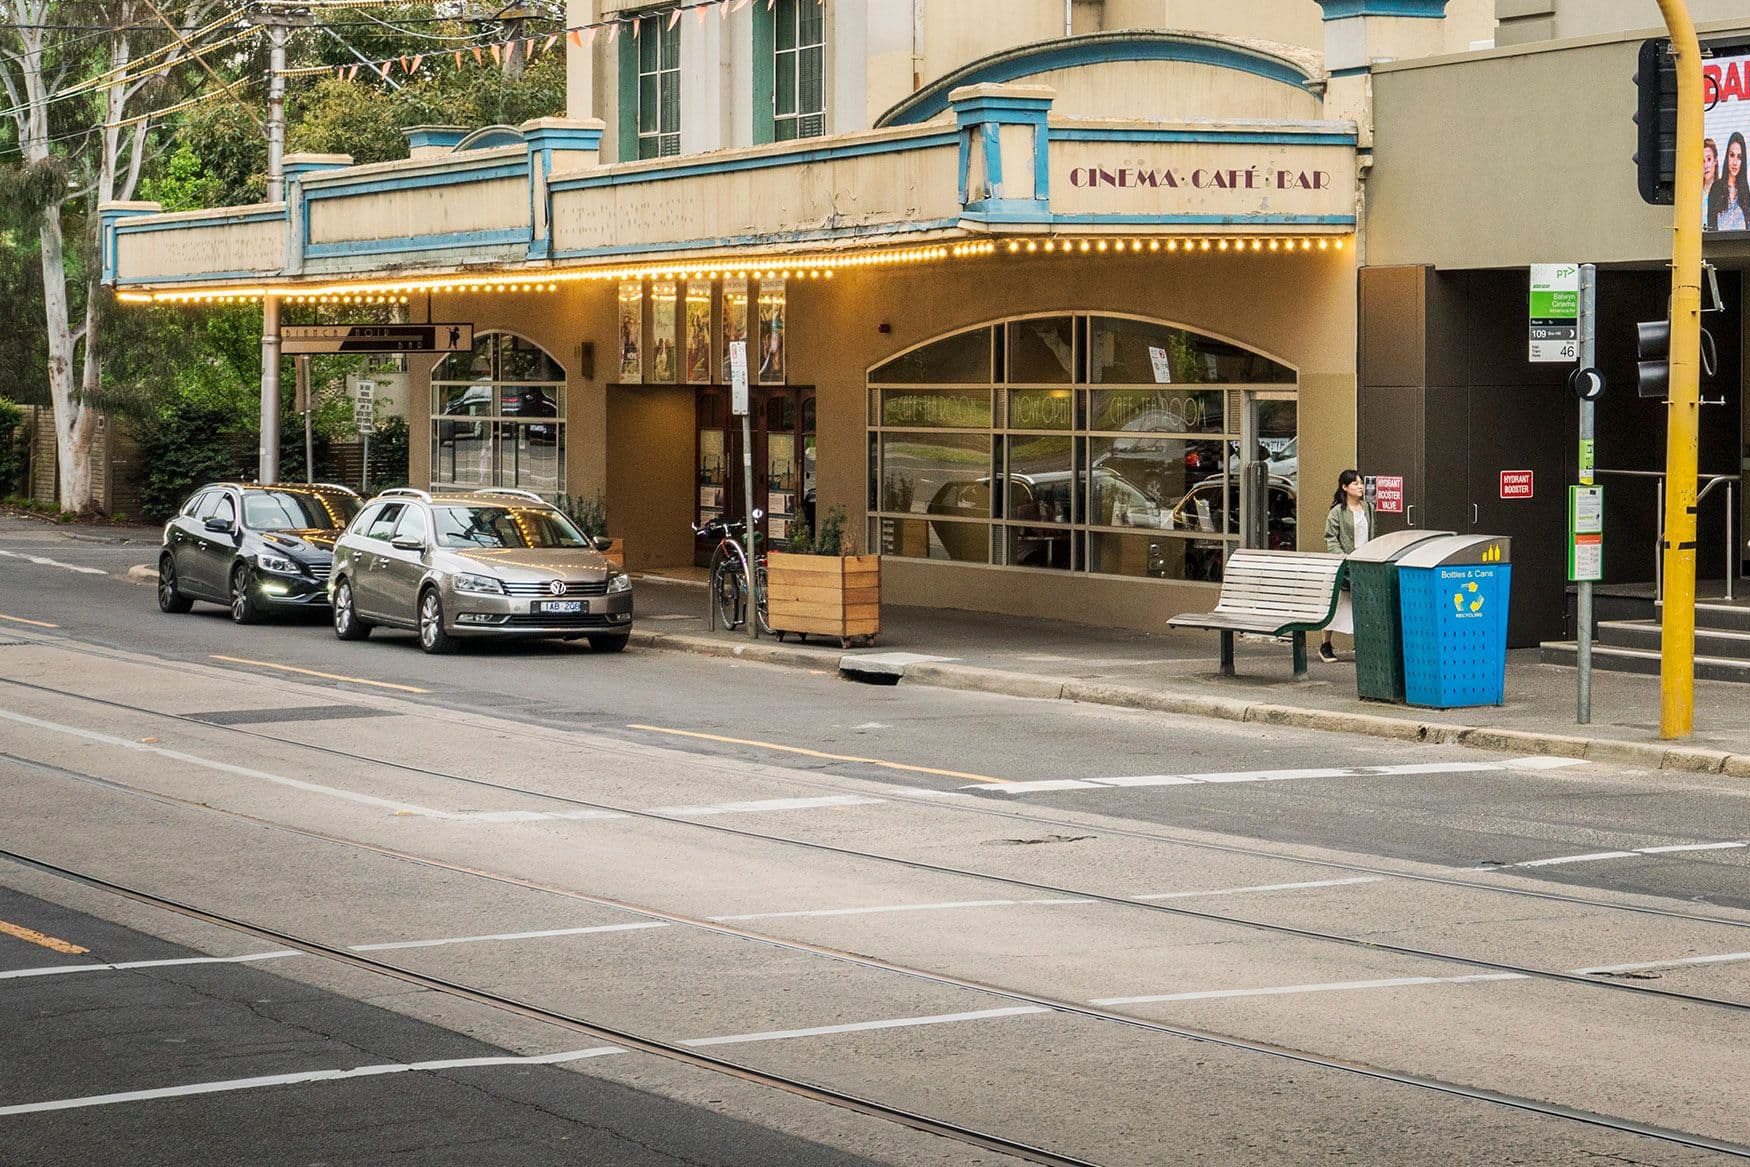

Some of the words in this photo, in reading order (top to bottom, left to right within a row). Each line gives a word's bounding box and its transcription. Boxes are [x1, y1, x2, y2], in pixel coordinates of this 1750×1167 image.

[1069, 167, 1179, 188] CINEMA
[1191, 165, 1261, 189] CAFÉ
[1277, 169, 1332, 190] BAR
[1532, 330, 1547, 338] 109
[1560, 346, 1575, 358] 46
[1504, 475, 1530, 483] HYDRANT
[1504, 485, 1529, 494] BOOSTER
[1441, 570, 1466, 579] Bottles
[1474, 570, 1494, 578] Cans
